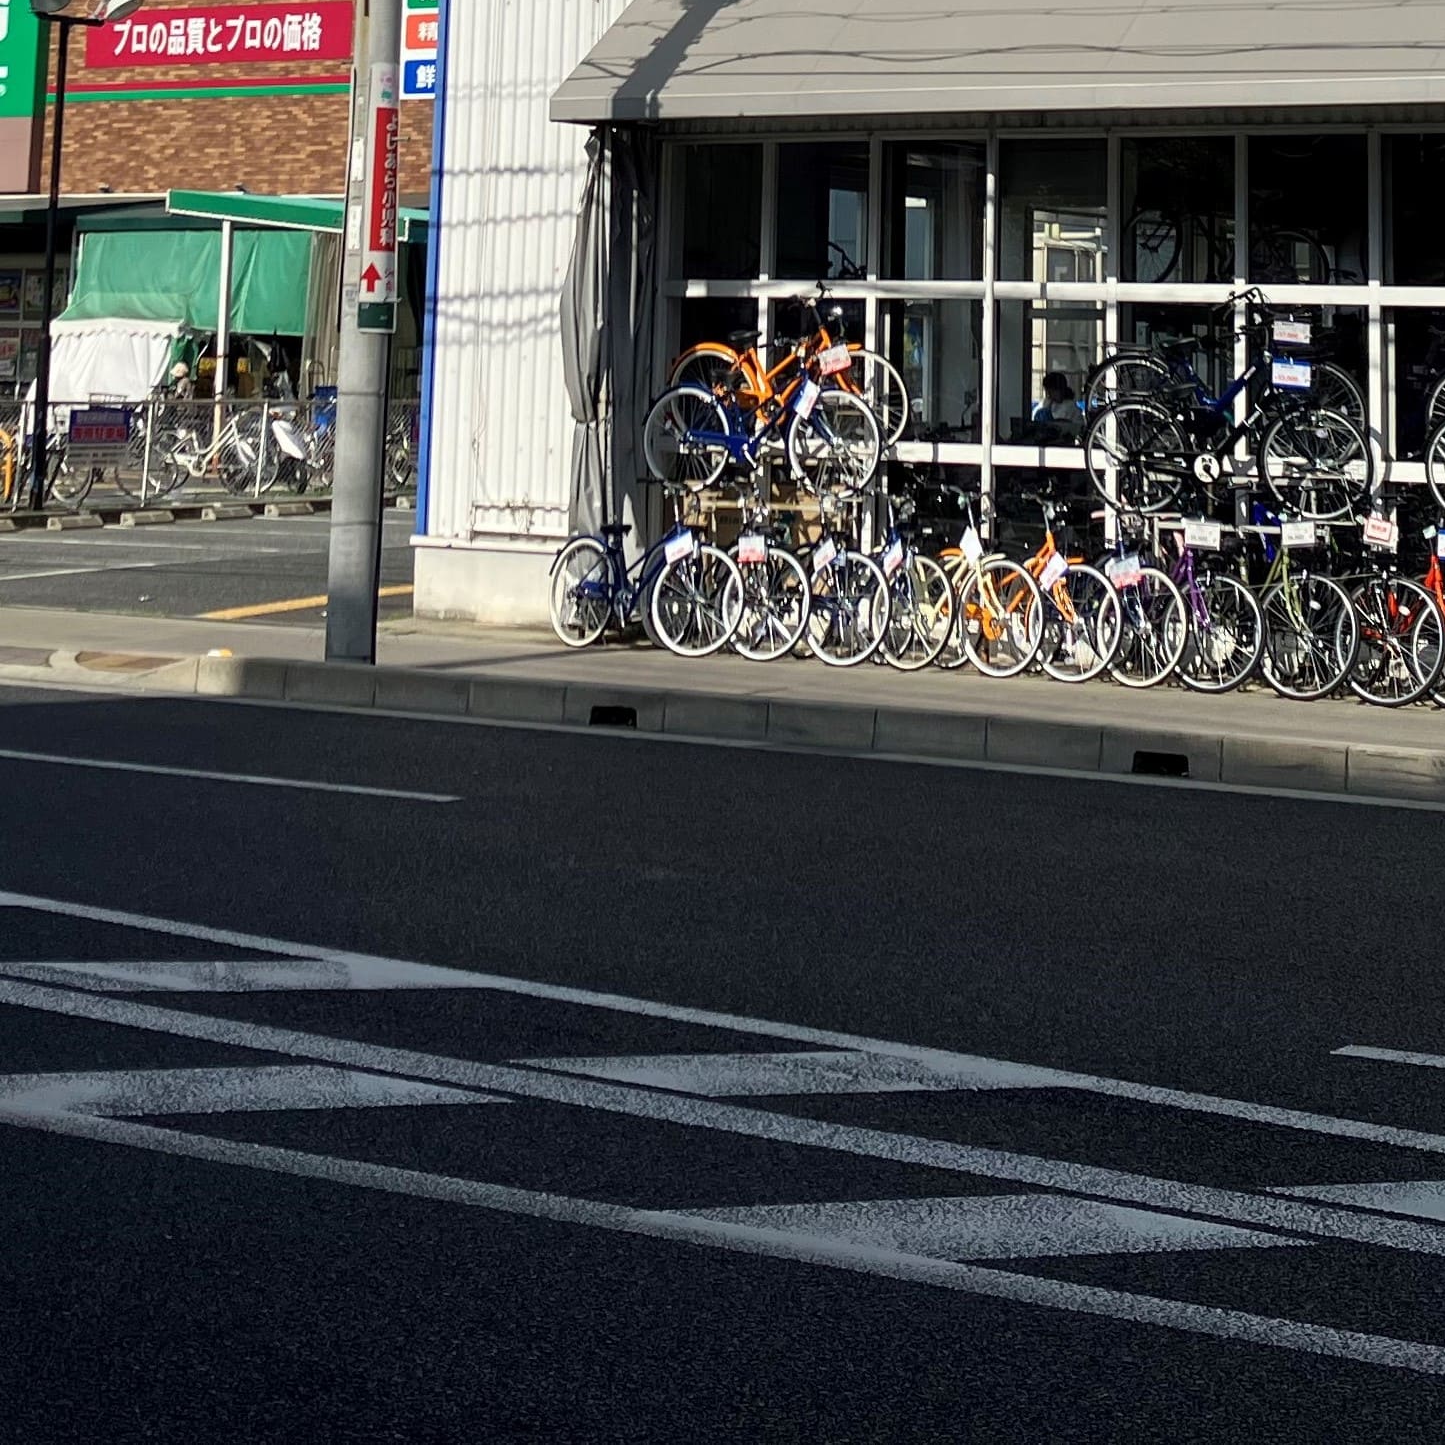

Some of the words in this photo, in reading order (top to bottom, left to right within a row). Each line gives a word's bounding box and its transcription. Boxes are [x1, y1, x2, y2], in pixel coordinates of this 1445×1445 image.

[113, 12, 323, 55] プロの品質とプロの価格
